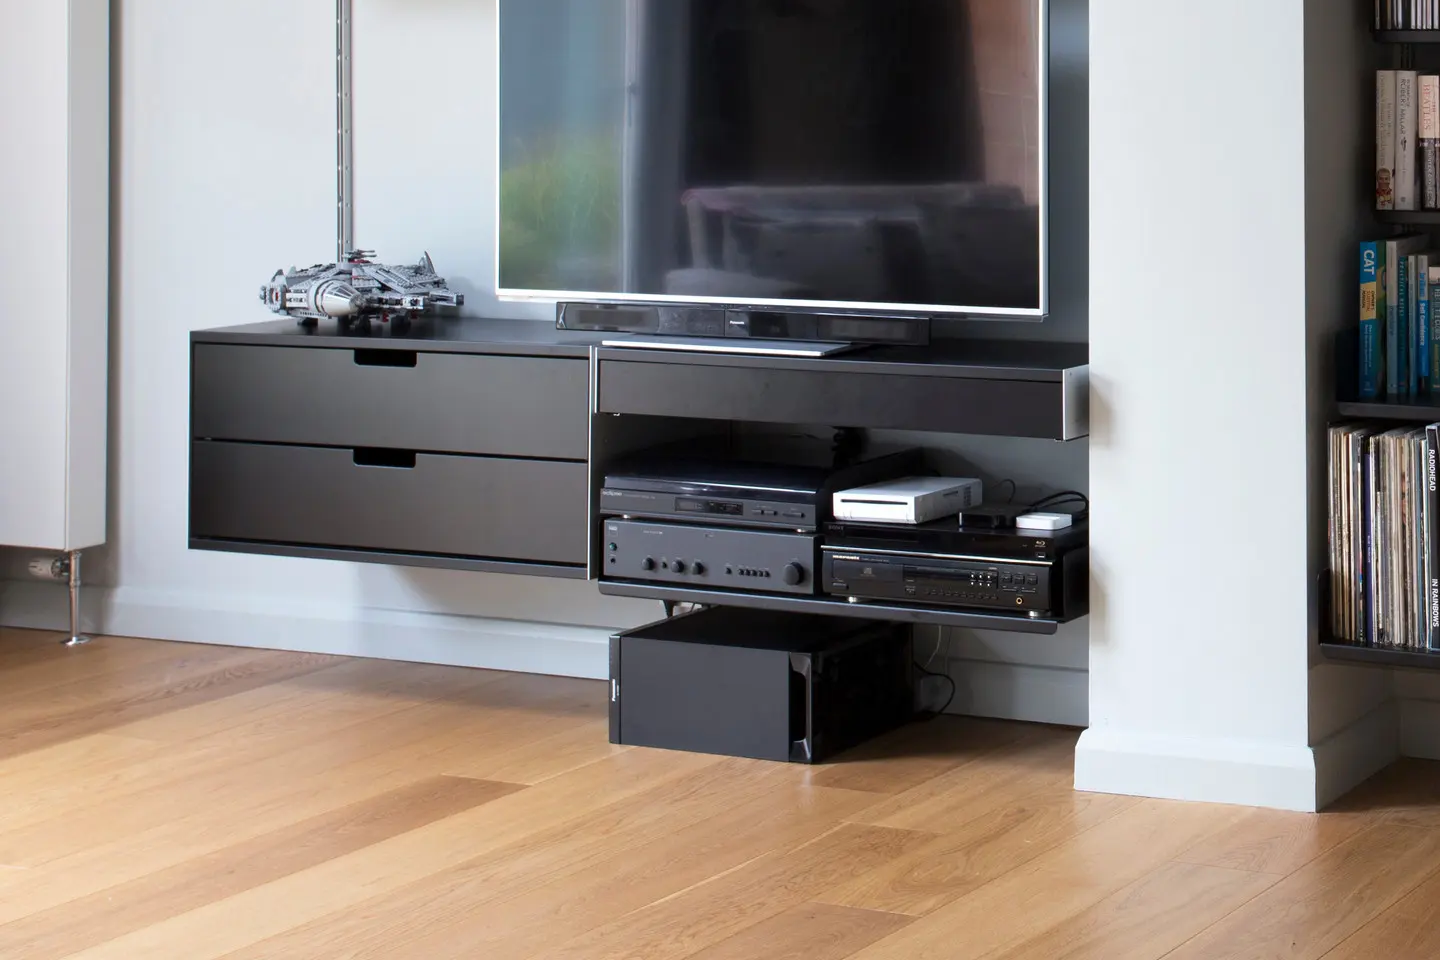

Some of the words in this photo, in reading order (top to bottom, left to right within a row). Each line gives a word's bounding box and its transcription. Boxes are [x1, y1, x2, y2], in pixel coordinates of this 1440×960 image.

[1423, 84, 1433, 131] BEATLES
[1363, 249, 1375, 275] CAT
[1428, 449, 1436, 491] RADIOHEAD
[1431, 578, 1438, 587] IN
[1431, 588, 1439, 627] RAINBOWS
